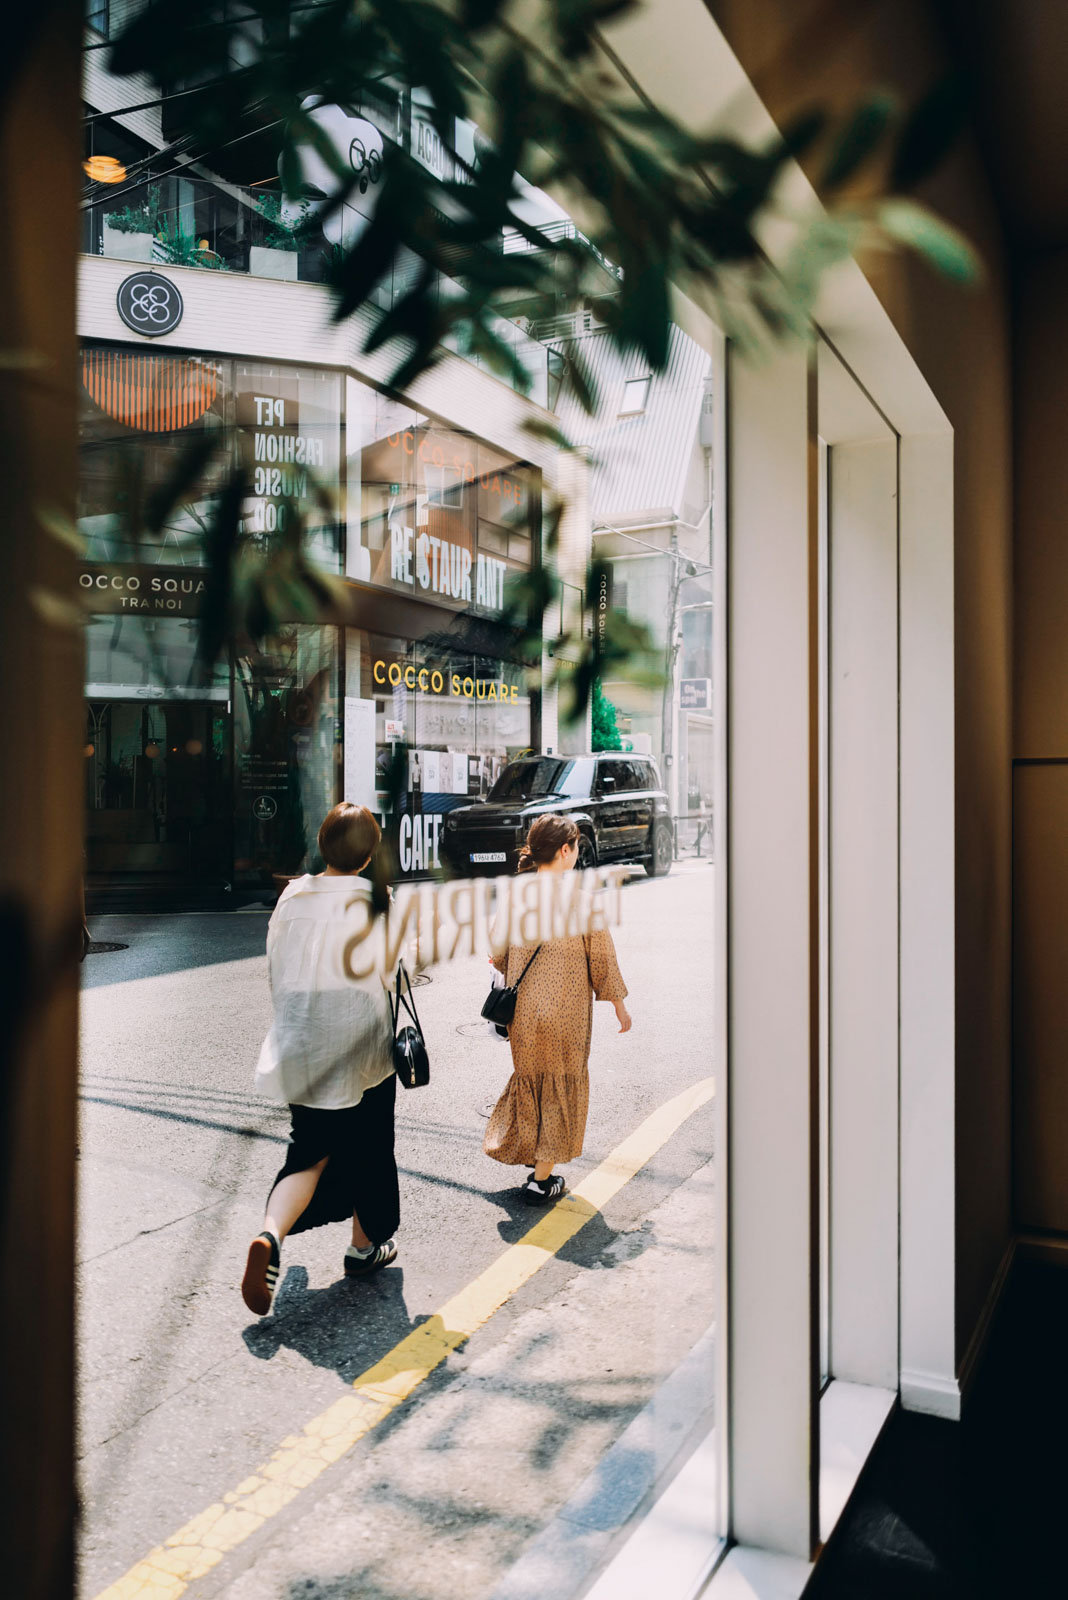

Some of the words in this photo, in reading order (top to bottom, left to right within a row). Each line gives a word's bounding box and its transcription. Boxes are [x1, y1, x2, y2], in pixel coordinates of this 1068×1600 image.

[378, 422, 444, 468] OCCO
[453, 456, 521, 505] SQUARE
[79, 574, 140, 590] OCCO
[151, 578, 206, 593] SQUA
[120, 597, 150, 608] TRA
[155, 599, 182, 609] NOI
[373, 660, 443, 693] COCCO
[452, 674, 519, 705] SQUARE
[399, 814, 442, 872] CAFE
